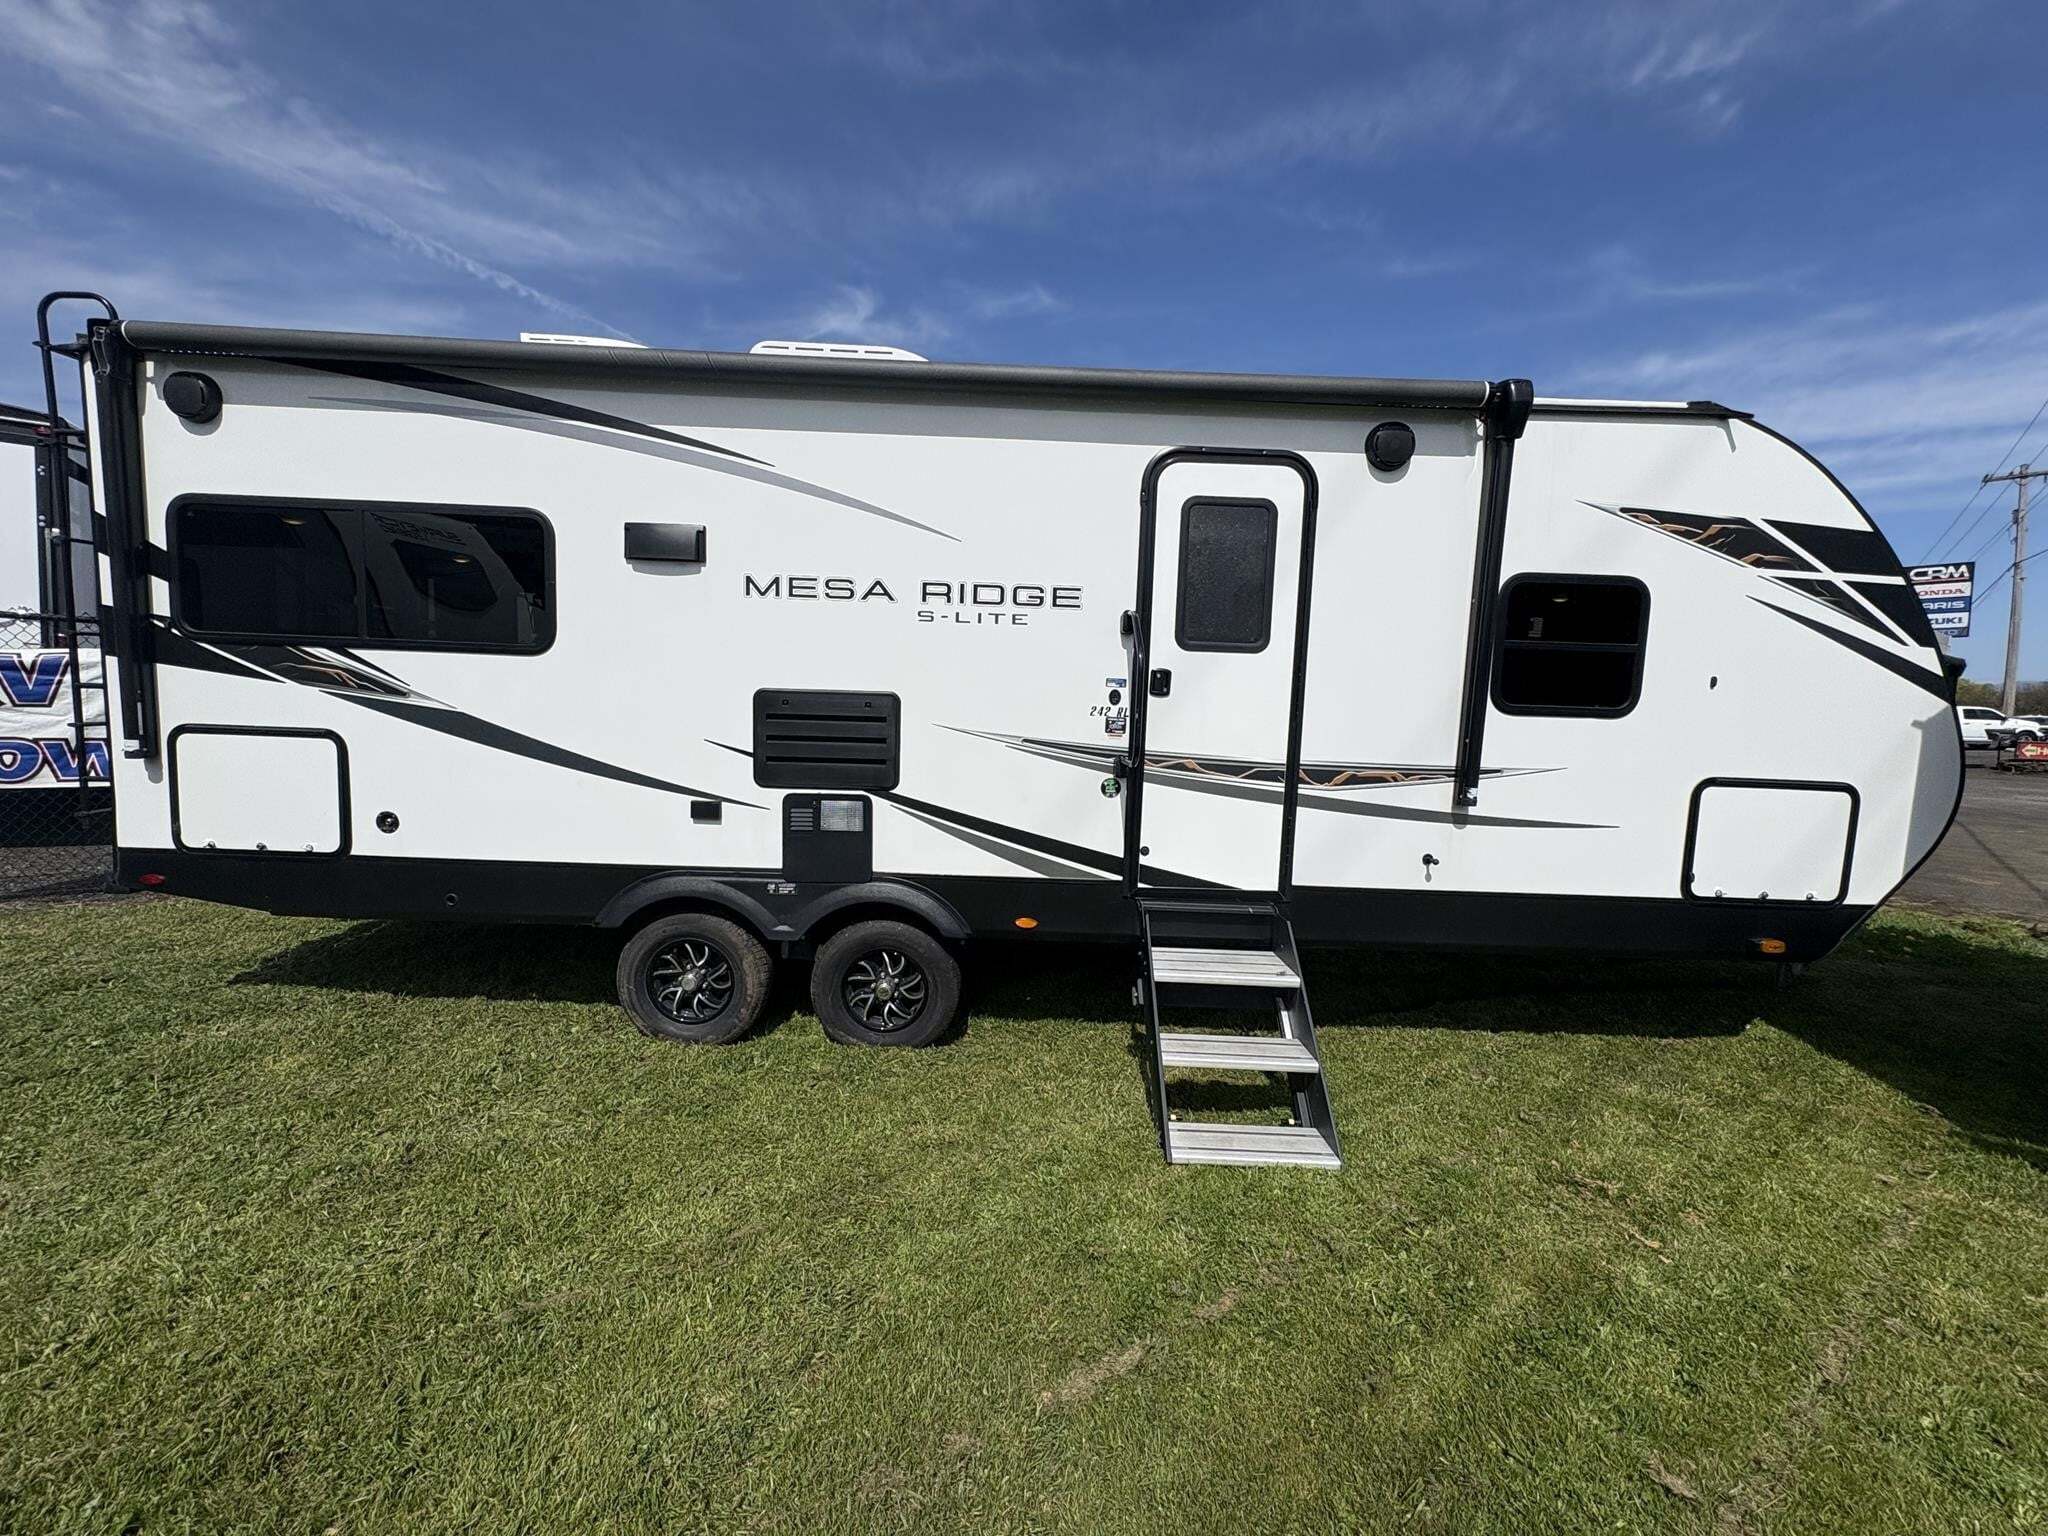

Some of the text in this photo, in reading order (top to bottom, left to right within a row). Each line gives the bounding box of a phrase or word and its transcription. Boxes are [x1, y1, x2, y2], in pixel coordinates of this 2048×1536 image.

[1909, 564, 1970, 581] CRM
[744, 574, 1084, 610] MESA RIDGE
[1918, 588, 1965, 597] ONDA
[1922, 600, 1965, 610] ARIS
[917, 610, 1029, 626] S-LITE
[0, 652, 71, 708] V
[1090, 705, 1111, 717] 242
[0, 736, 112, 784] OW
